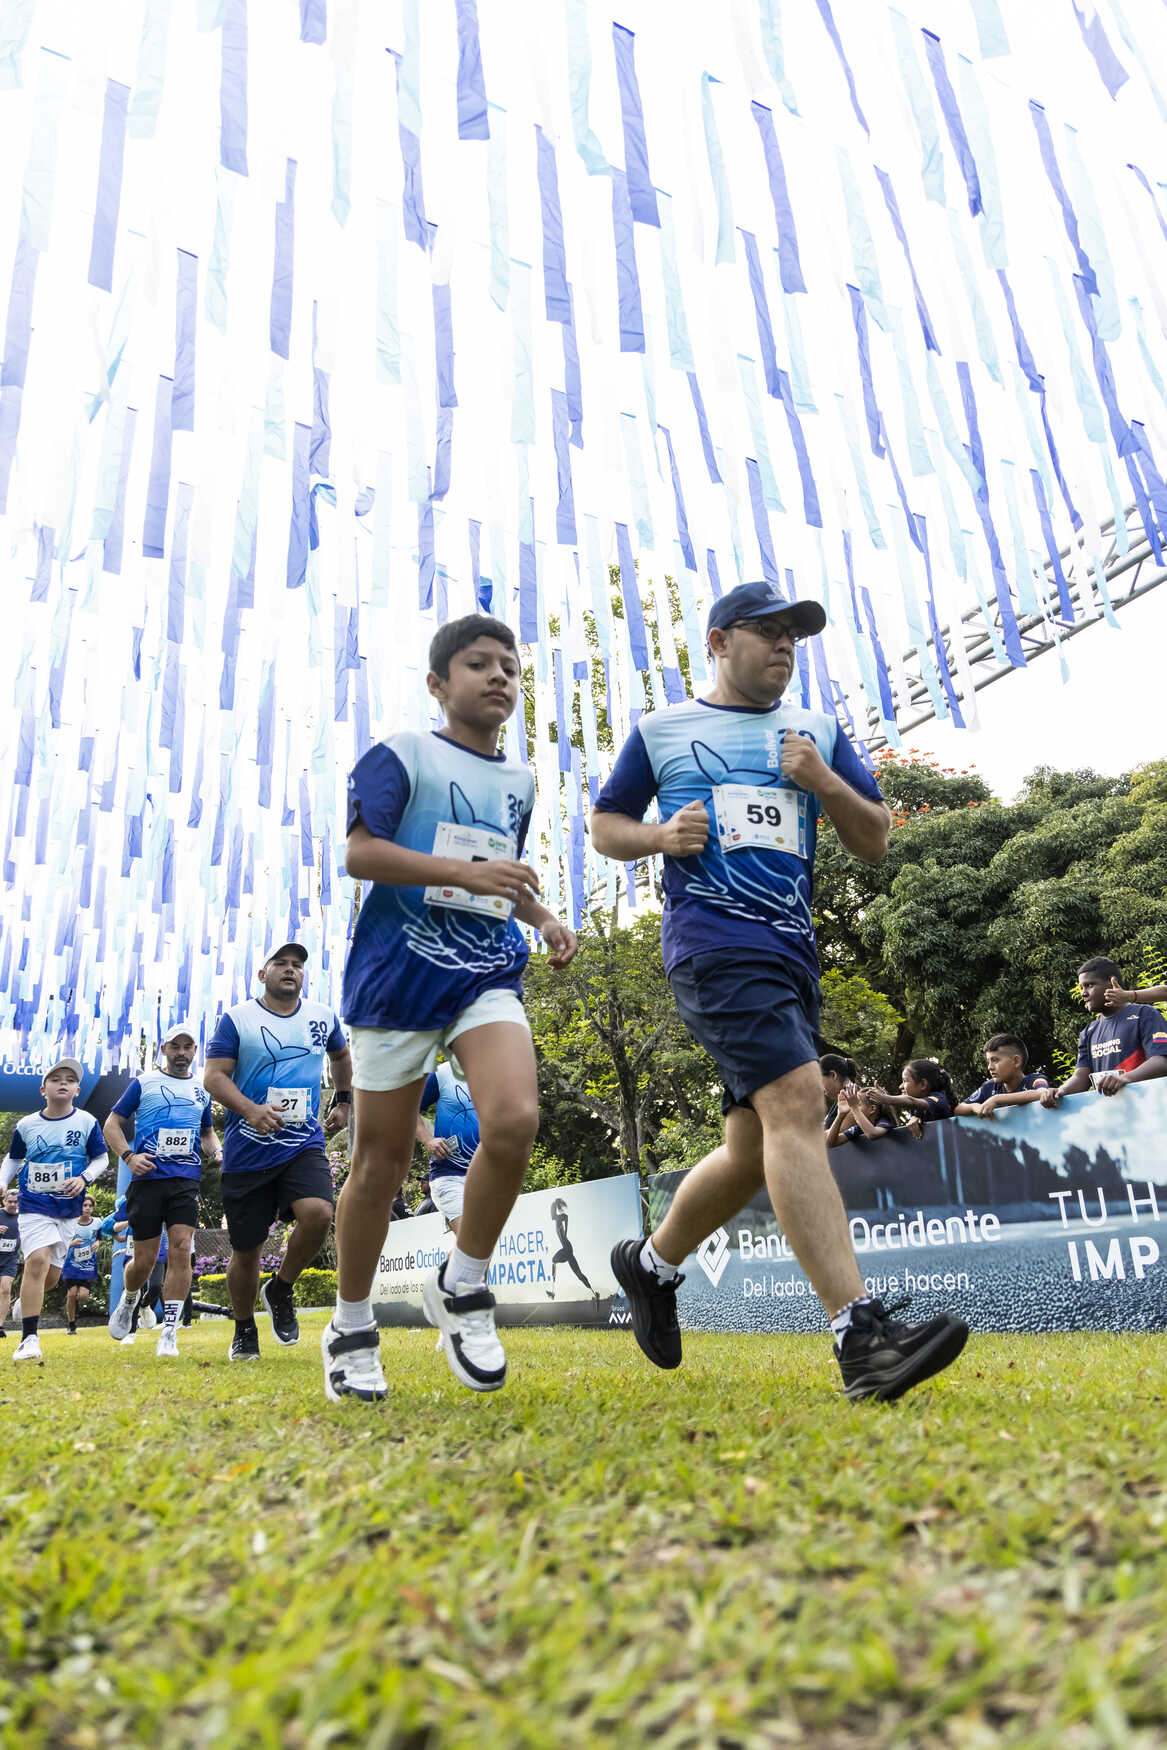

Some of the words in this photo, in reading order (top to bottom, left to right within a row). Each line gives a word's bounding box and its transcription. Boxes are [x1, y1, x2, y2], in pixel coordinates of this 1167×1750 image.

[747, 804, 781, 827] 59
[309, 1020, 327, 1034] 20
[312, 1033, 327, 1047] 26
[1091, 1045, 1122, 1059] SOCIAL
[281, 1098, 298, 1110] 27
[66, 1138, 80, 1147] 26
[67, 1130, 81, 1138] 20
[165, 1137, 187, 1146] 882
[34, 1172, 58, 1182] 881
[1048, 1186, 1107, 1229] TU
[1126, 1181, 1160, 1223] H
[848, 1209, 1001, 1251] Occidente
[499, 1230, 549, 1256] HACER,
[380, 1255, 404, 1273] Banco
[404, 1251, 415, 1270] de
[1067, 1236, 1160, 1282] IMP
[743, 1275, 766, 1297] Del
[771, 1274, 806, 1297] lado
[864, 1275, 899, 1298] que
[905, 1267, 975, 1292] hacen.
[165, 1303, 178, 1327] YEAH
